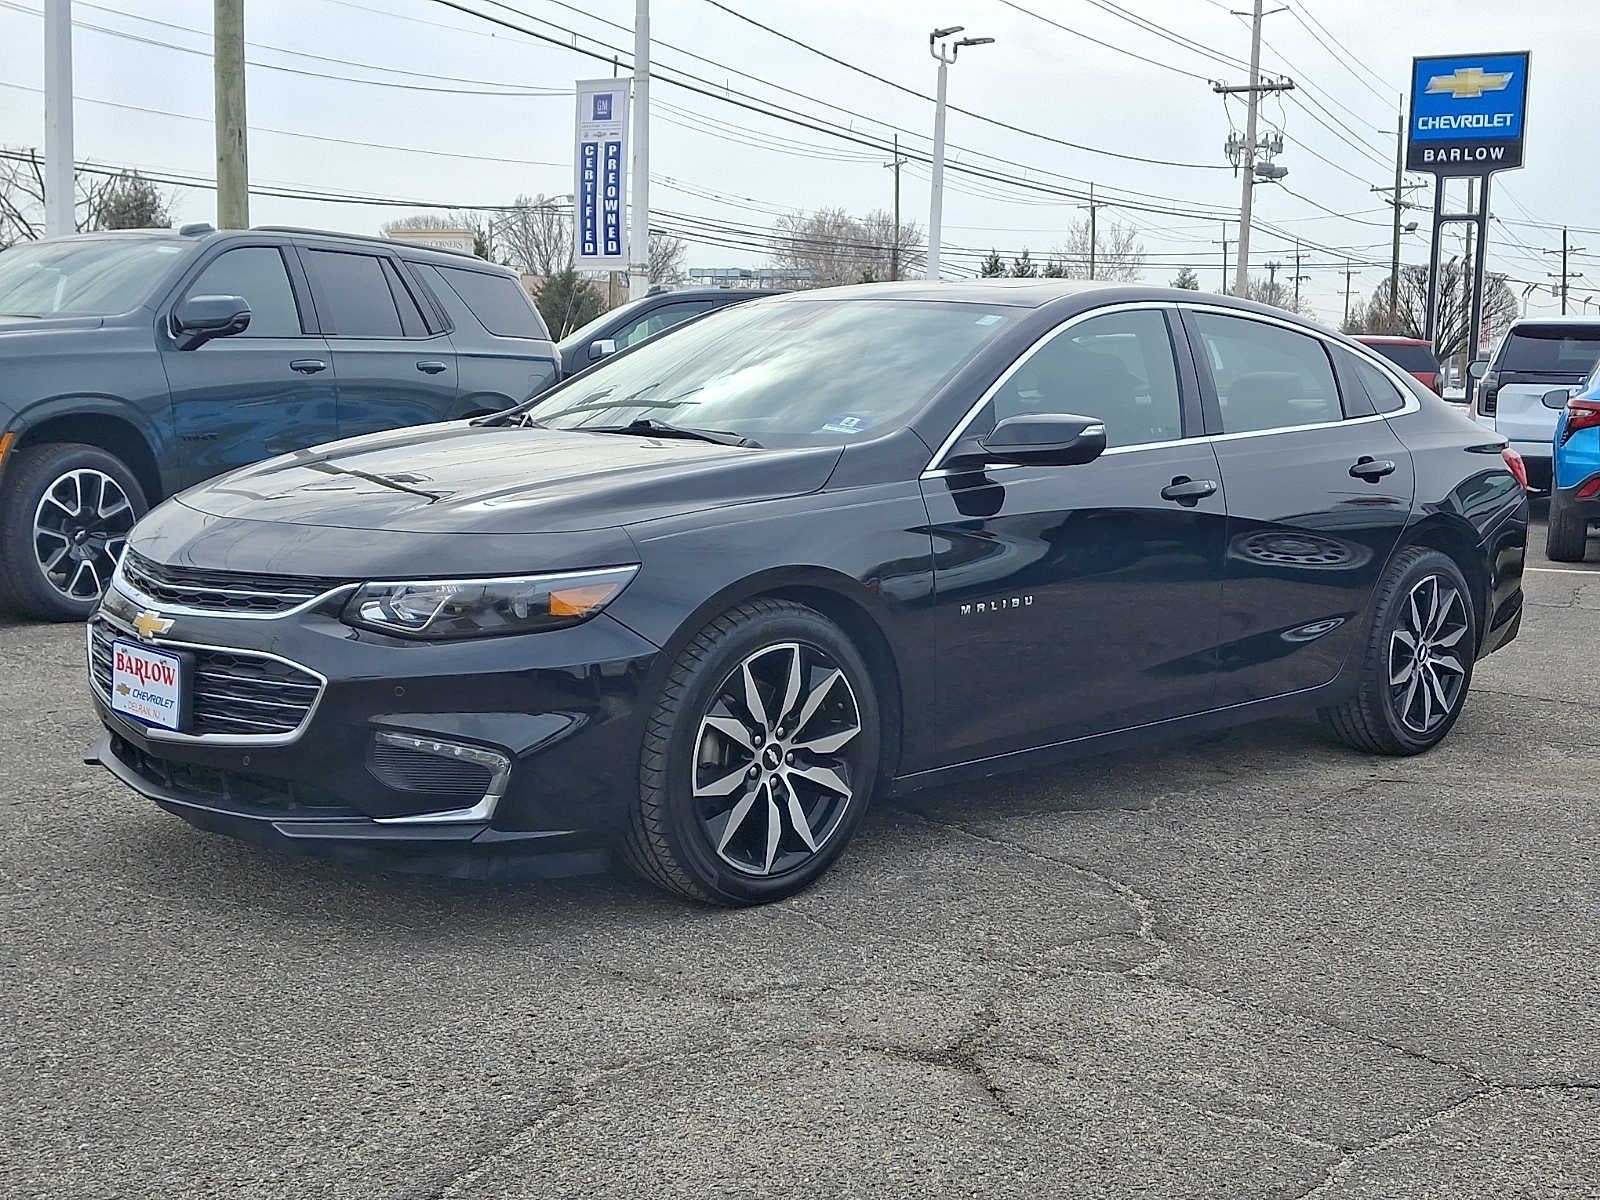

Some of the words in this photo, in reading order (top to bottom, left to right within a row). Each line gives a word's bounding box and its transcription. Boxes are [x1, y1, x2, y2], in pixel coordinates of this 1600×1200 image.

[597, 100, 608, 112] GM
[1418, 113, 1514, 130] CHEVROLET
[1423, 147, 1505, 162] BARLOW
[584, 145, 594, 253] CERTIFIED
[604, 145, 618, 252] PREOWNED
[960, 595, 1034, 616] MALIBU
[116, 653, 176, 687] BARLOW
[132, 688, 175, 709] CHEVROLET
